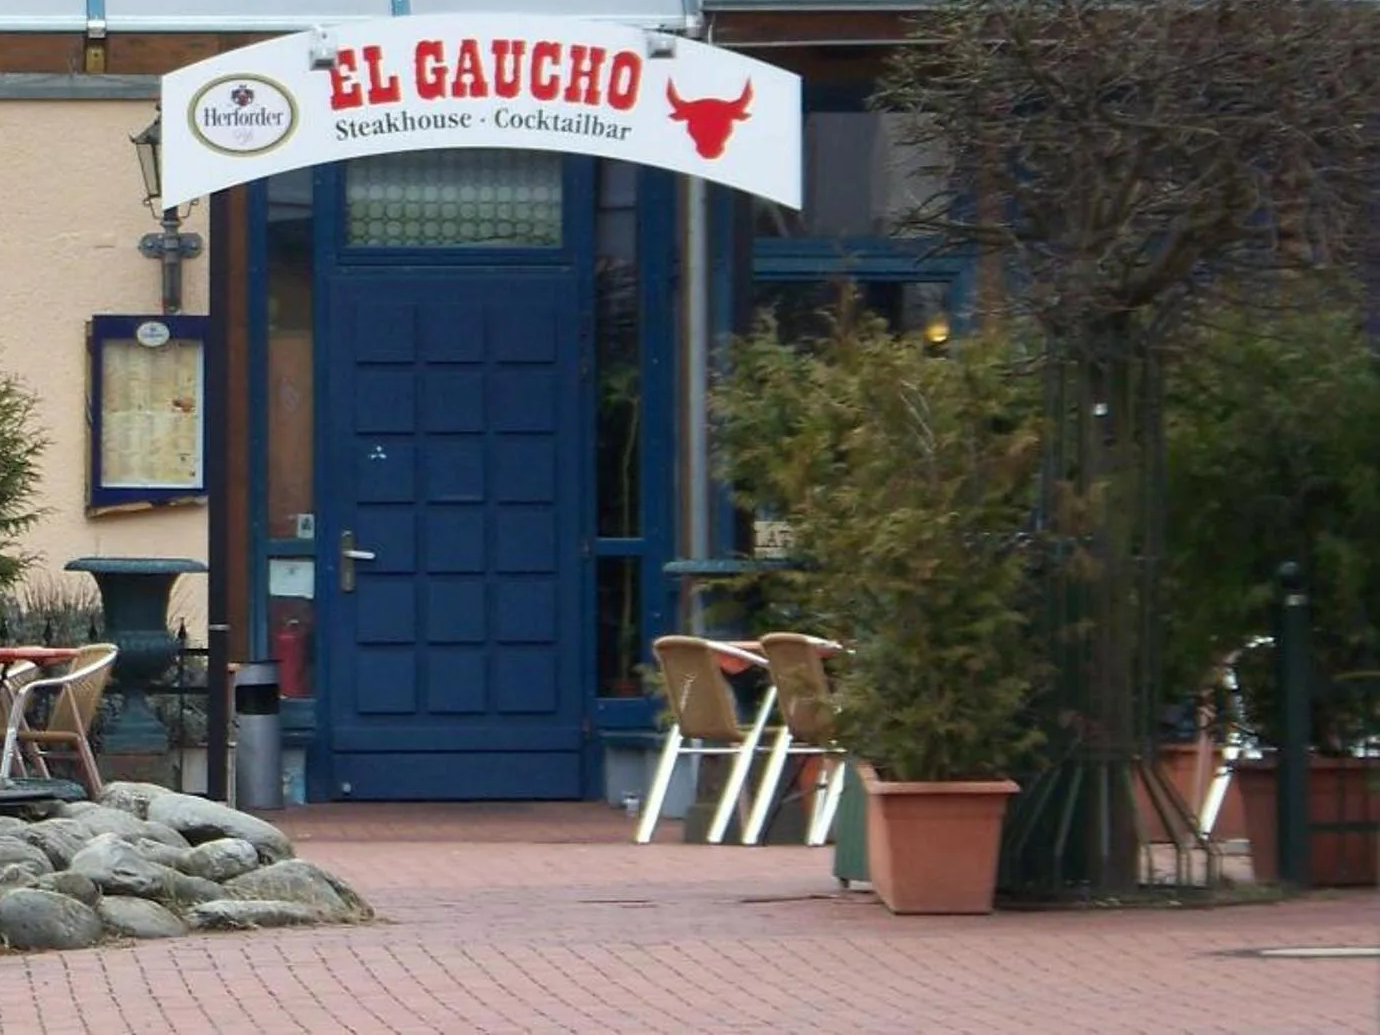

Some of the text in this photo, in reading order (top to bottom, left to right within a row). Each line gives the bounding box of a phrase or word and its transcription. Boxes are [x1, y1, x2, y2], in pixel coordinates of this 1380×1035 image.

[329, 39, 643, 111] EL GAUCHO
[204, 106, 284, 127] Herforder
[335, 107, 632, 141] Steakhouse Cocktailbar
